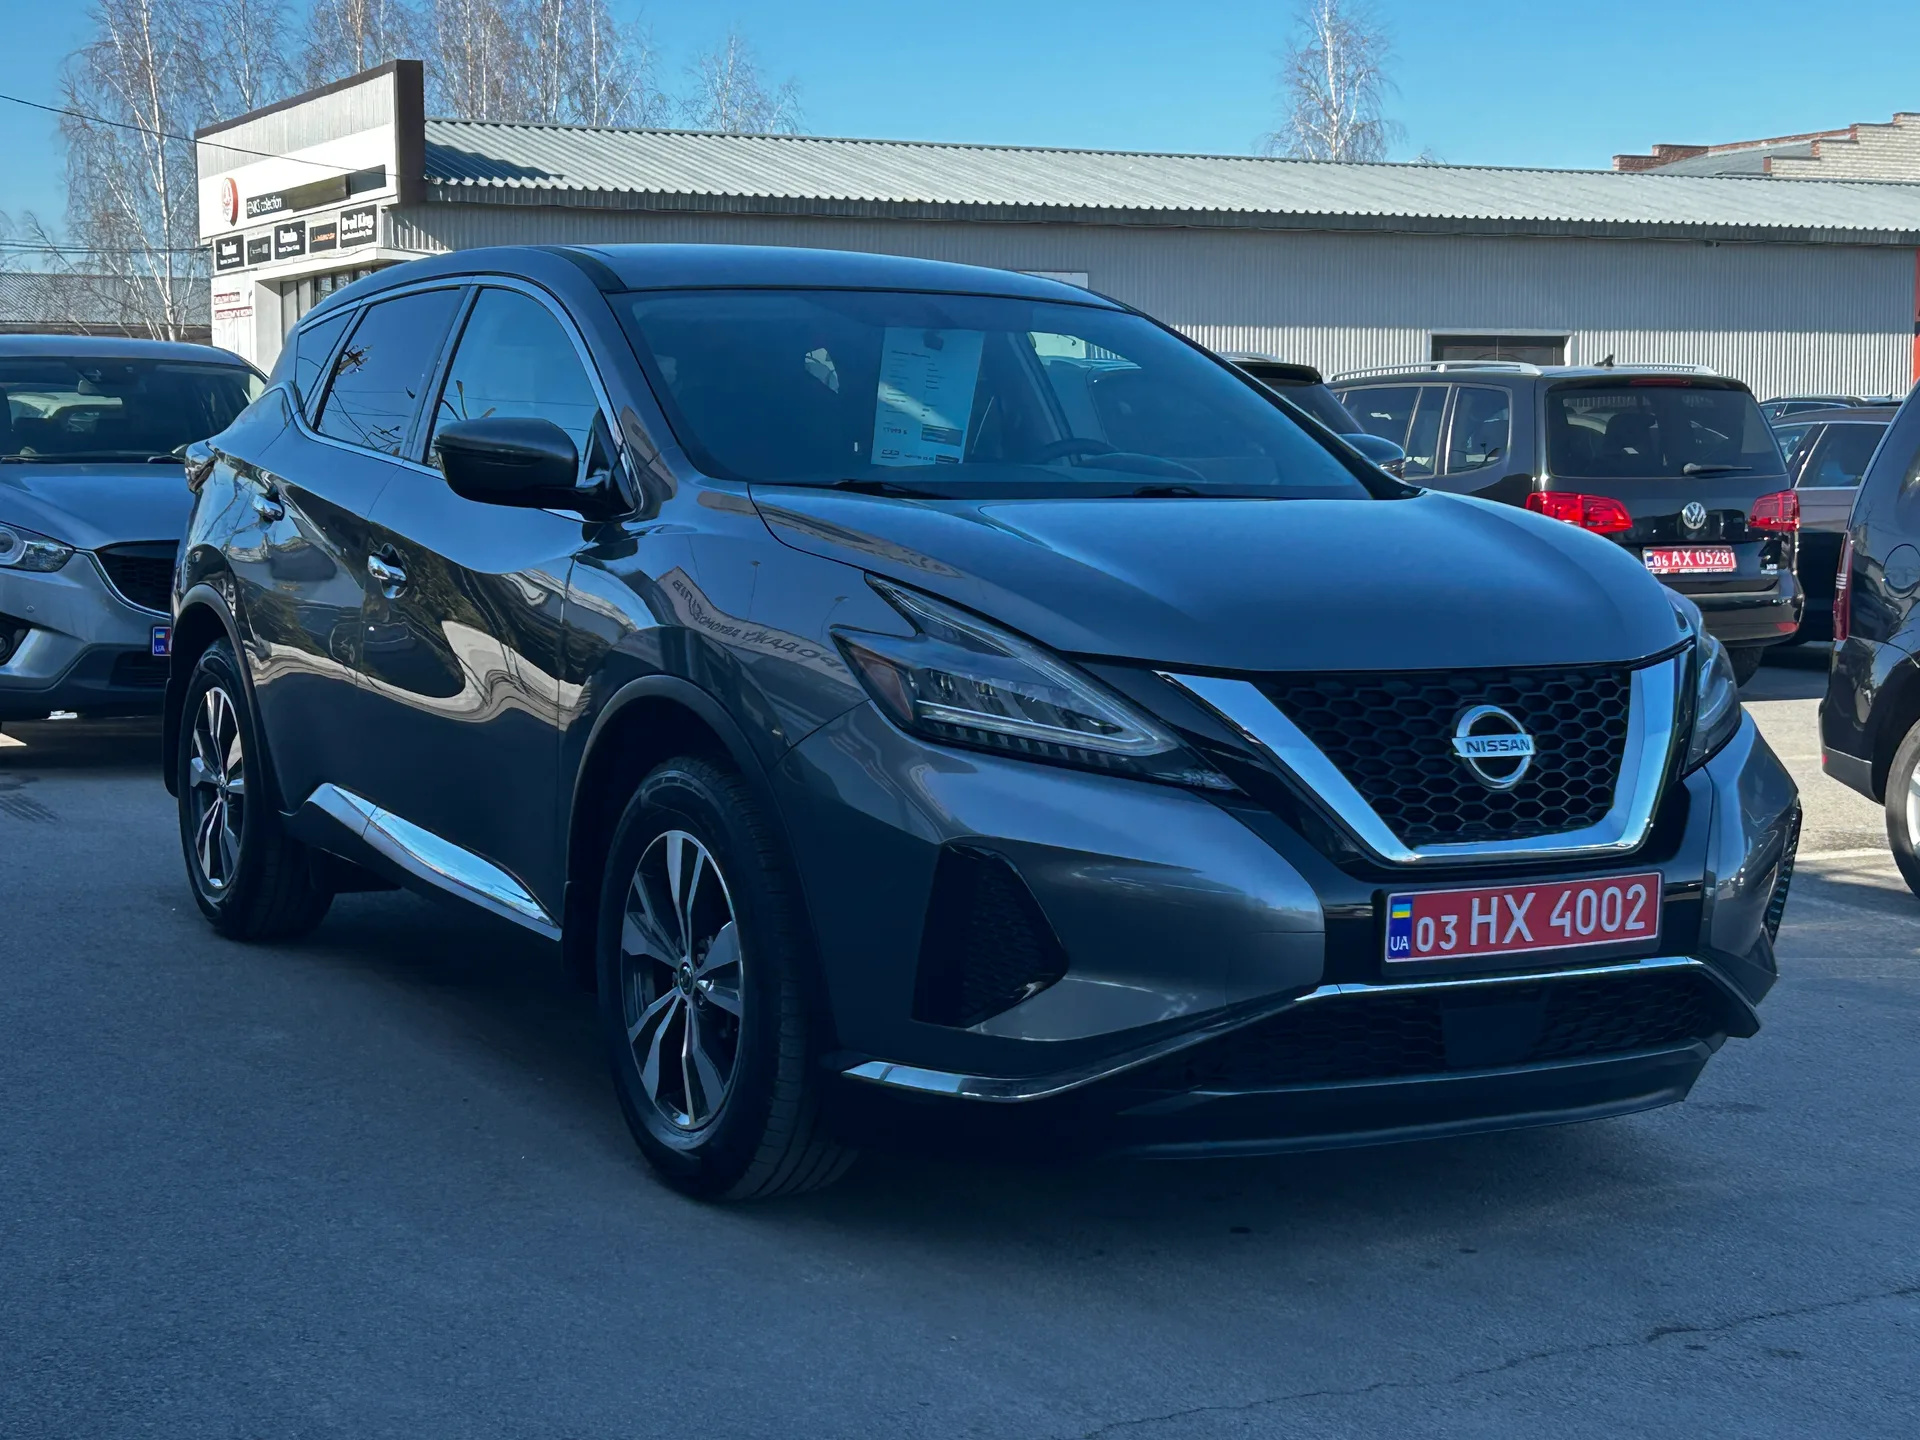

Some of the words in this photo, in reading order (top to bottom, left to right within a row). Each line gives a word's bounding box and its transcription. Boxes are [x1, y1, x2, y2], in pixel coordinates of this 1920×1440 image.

[1653, 555, 1668, 567] 06
[1672, 550, 1693, 566] AX
[1696, 550, 1729, 565] 0528
[1465, 739, 1530, 753] NISSAN
[1416, 915, 1458, 952] 03
[1470, 892, 1536, 946] HX
[1550, 884, 1646, 937] 4002
[1390, 936, 1409, 951] UA
